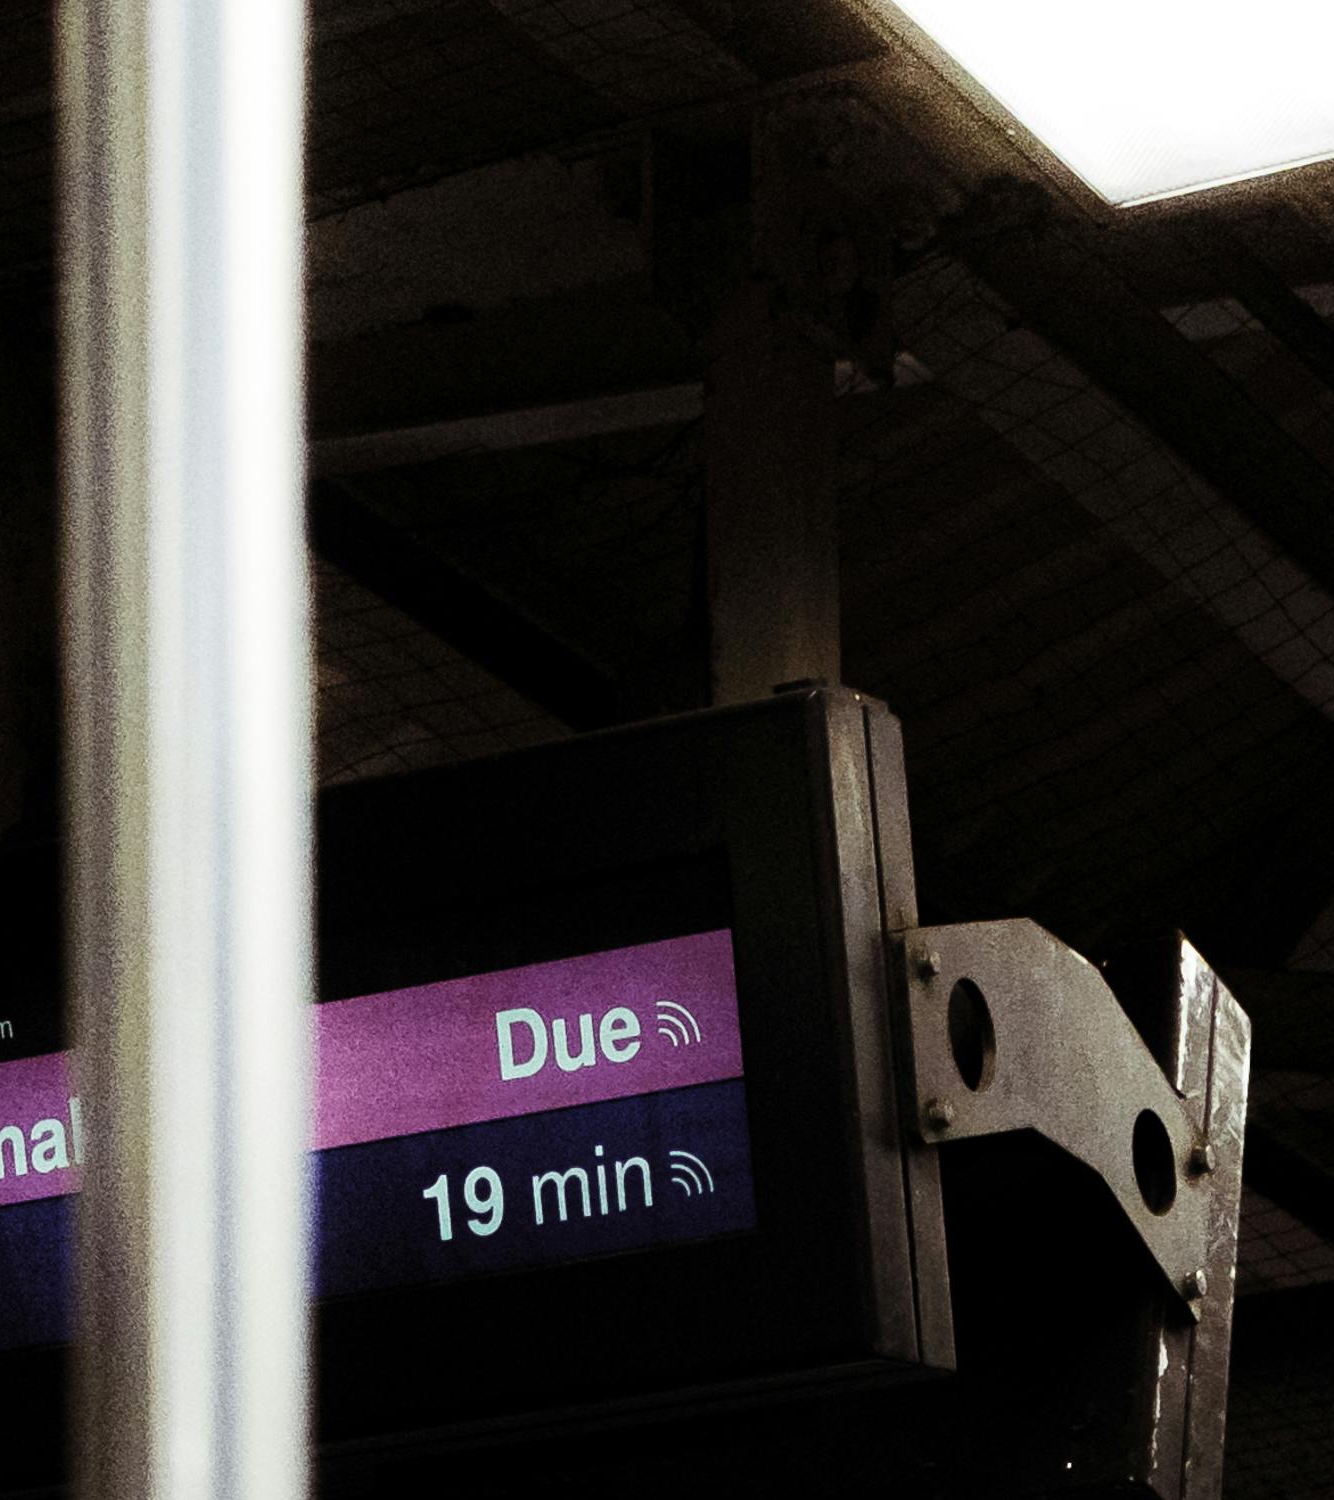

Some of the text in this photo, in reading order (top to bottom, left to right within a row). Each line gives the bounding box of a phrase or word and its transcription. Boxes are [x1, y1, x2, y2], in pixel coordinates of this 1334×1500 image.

[495, 1004, 642, 1082] Due
[423, 1145, 654, 1242] 19 min
